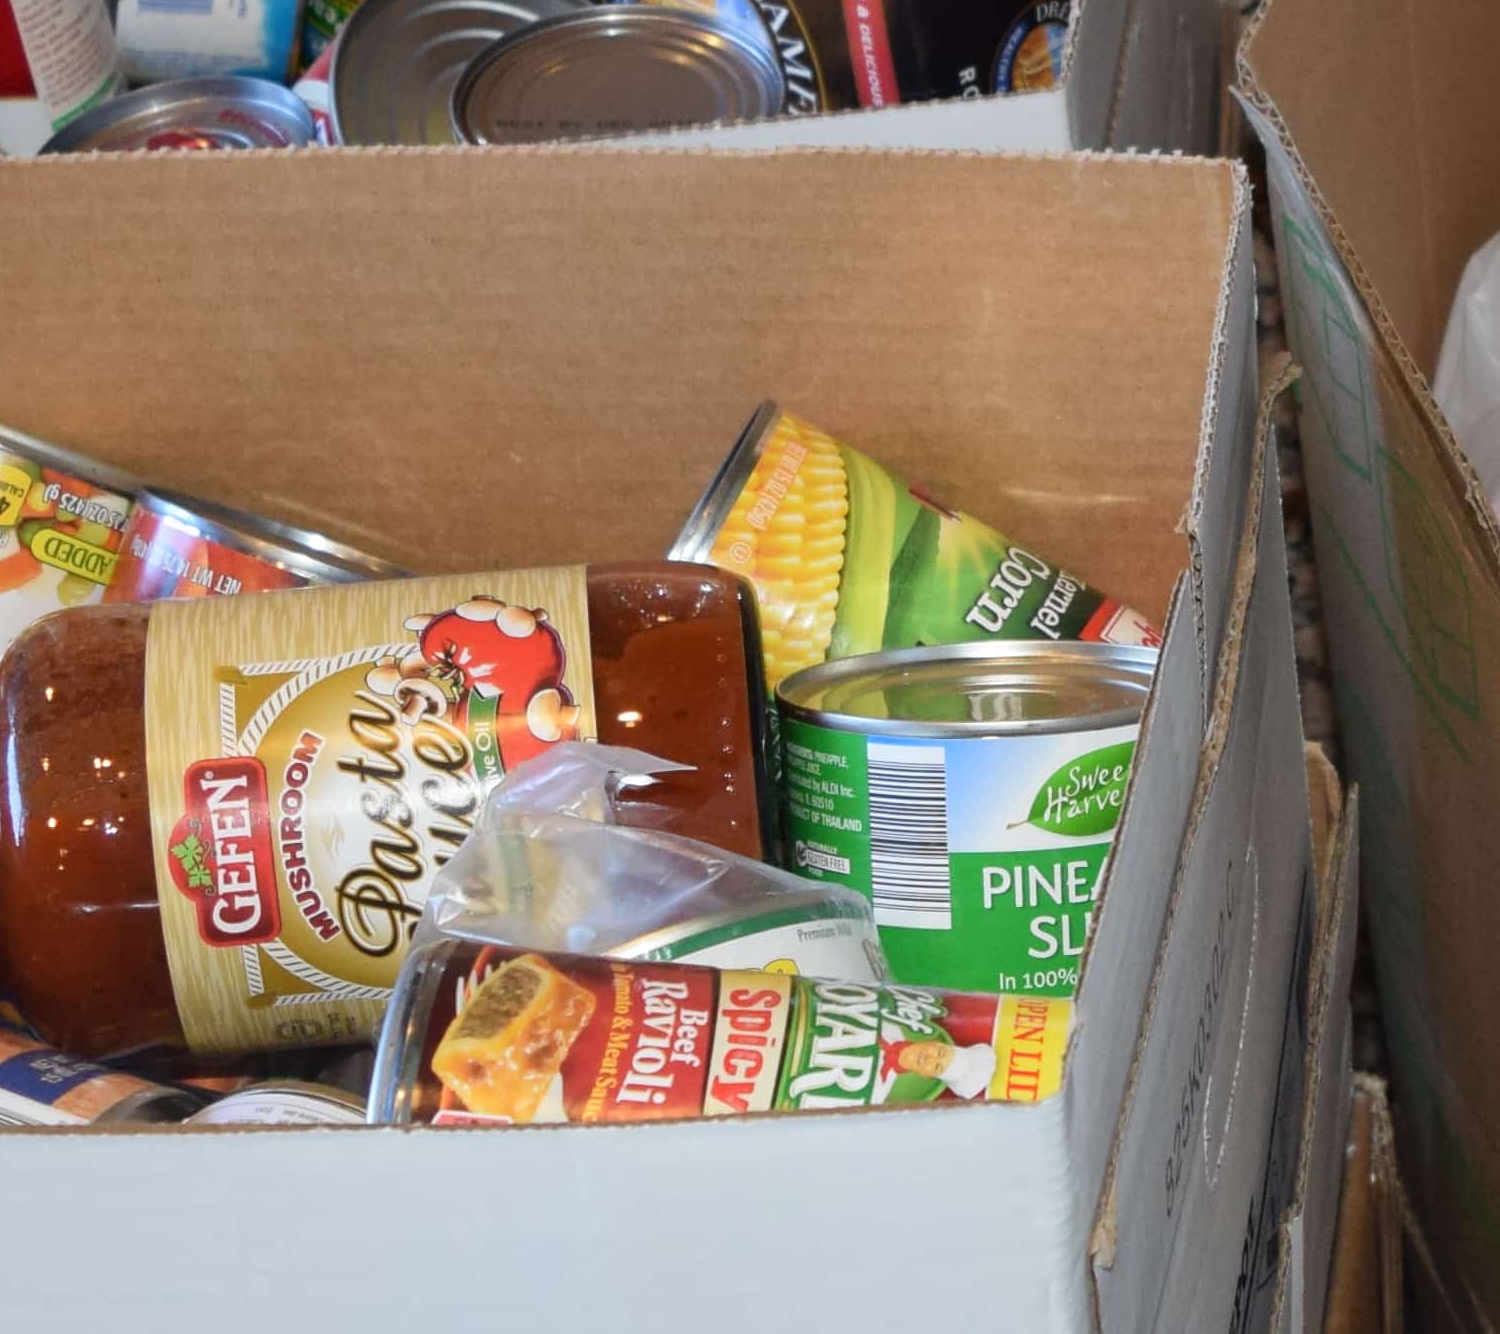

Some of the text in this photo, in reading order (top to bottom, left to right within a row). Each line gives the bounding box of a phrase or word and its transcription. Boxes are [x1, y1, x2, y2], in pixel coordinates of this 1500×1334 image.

[858, 22, 884, 108] DELICIOUS
[41, 480, 110, 524] OZ (425 g)
[40, 535, 113, 577] ADDED
[189, 564, 242, 595] NET WT
[964, 545, 1048, 635] Corn
[473, 720, 493, 751] Oil
[821, 781, 854, 797] ALDI Inc.
[279, 731, 341, 943] MUSHROOM
[335, 689, 425, 958] Pasta
[810, 810, 862, 831] OF THAILAND
[210, 774, 263, 934] GEFEN
[998, 967, 1077, 991] In 100%
[600, 1015, 633, 1073] & Meat
[616, 979, 690, 1106] Ravioli
[669, 1007, 710, 1069] Beef
[709, 987, 783, 1113] Spicy
